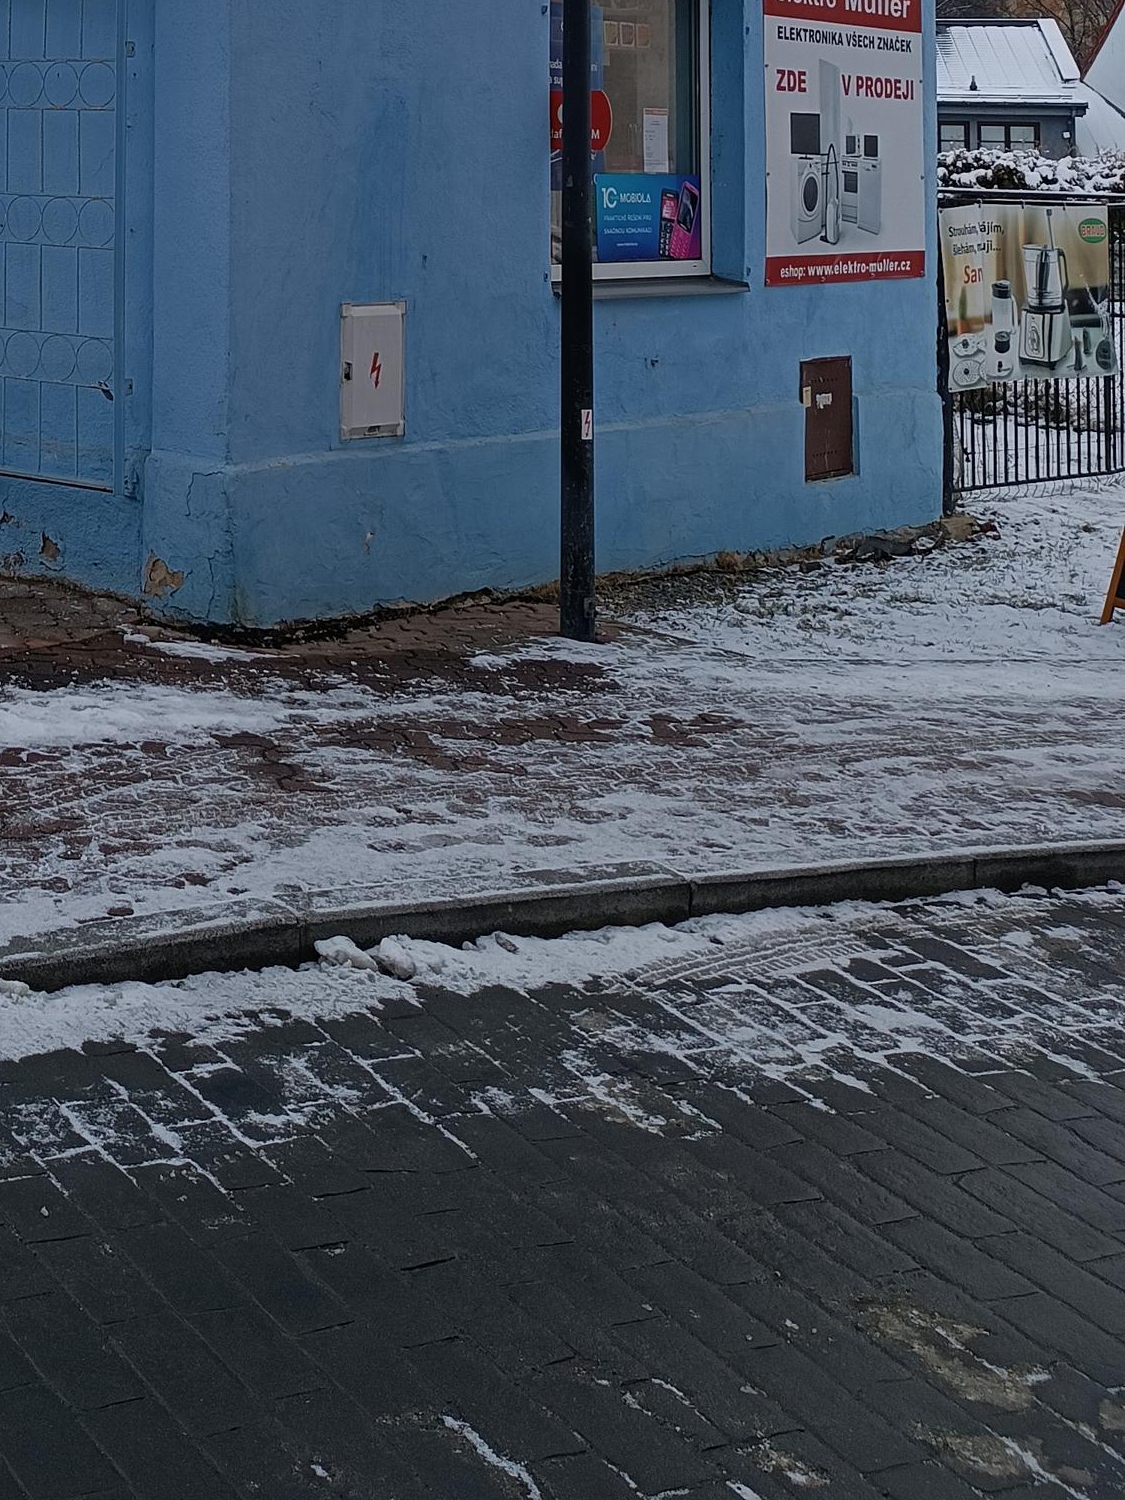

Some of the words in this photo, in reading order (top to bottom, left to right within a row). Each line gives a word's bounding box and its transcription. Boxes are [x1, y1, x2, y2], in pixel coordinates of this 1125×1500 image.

[777, 25, 844, 47] ELEKTRONIKA
[845, 30, 875, 50] VŠECH
[877, 35, 912, 53] ZNAČEK
[776, 69, 807, 93] ZDE
[841, 74, 851, 96] V
[855, 75, 915, 100] PRODEJI
[780, 264, 806, 281] eshop:
[807, 258, 911, 277] www.elektro-muller.cz
